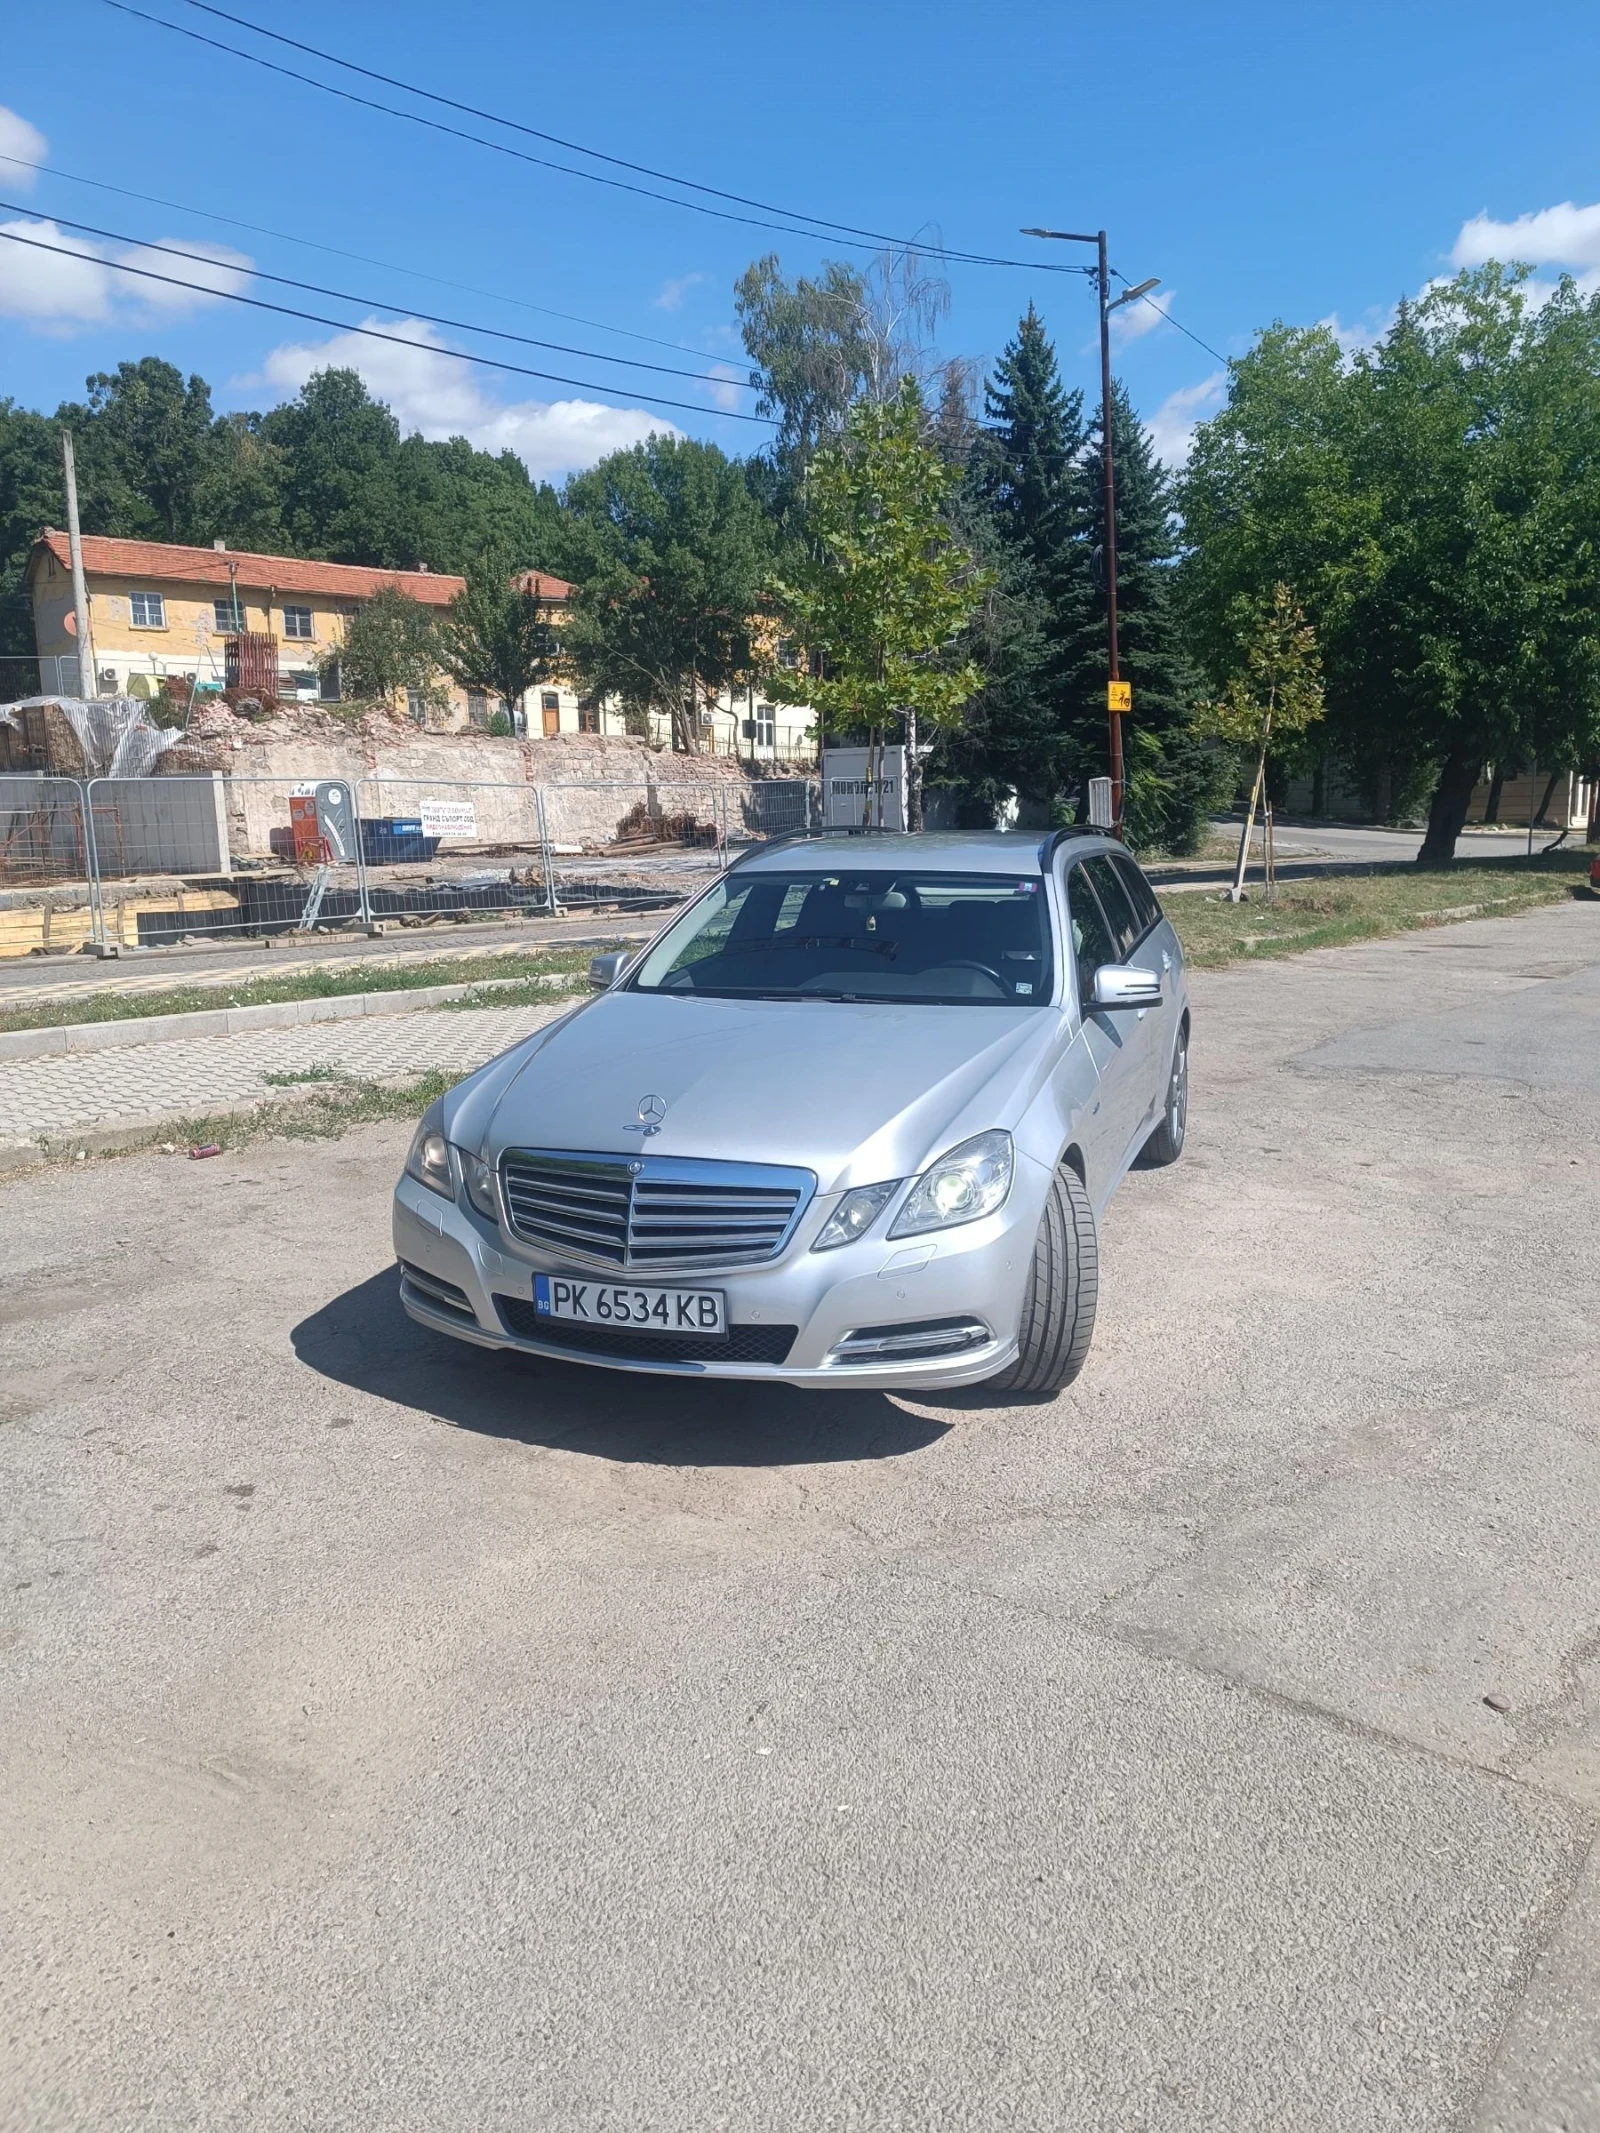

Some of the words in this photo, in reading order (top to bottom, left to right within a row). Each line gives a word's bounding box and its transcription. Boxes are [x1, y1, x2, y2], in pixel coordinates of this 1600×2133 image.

[883, 780, 894, 794] 21
[423, 814, 441, 823] ГРАНД
[538, 1299, 550, 1311] BG
[553, 1282, 590, 1318] PK
[596, 1288, 670, 1325] 6534
[676, 1294, 719, 1328] KB
